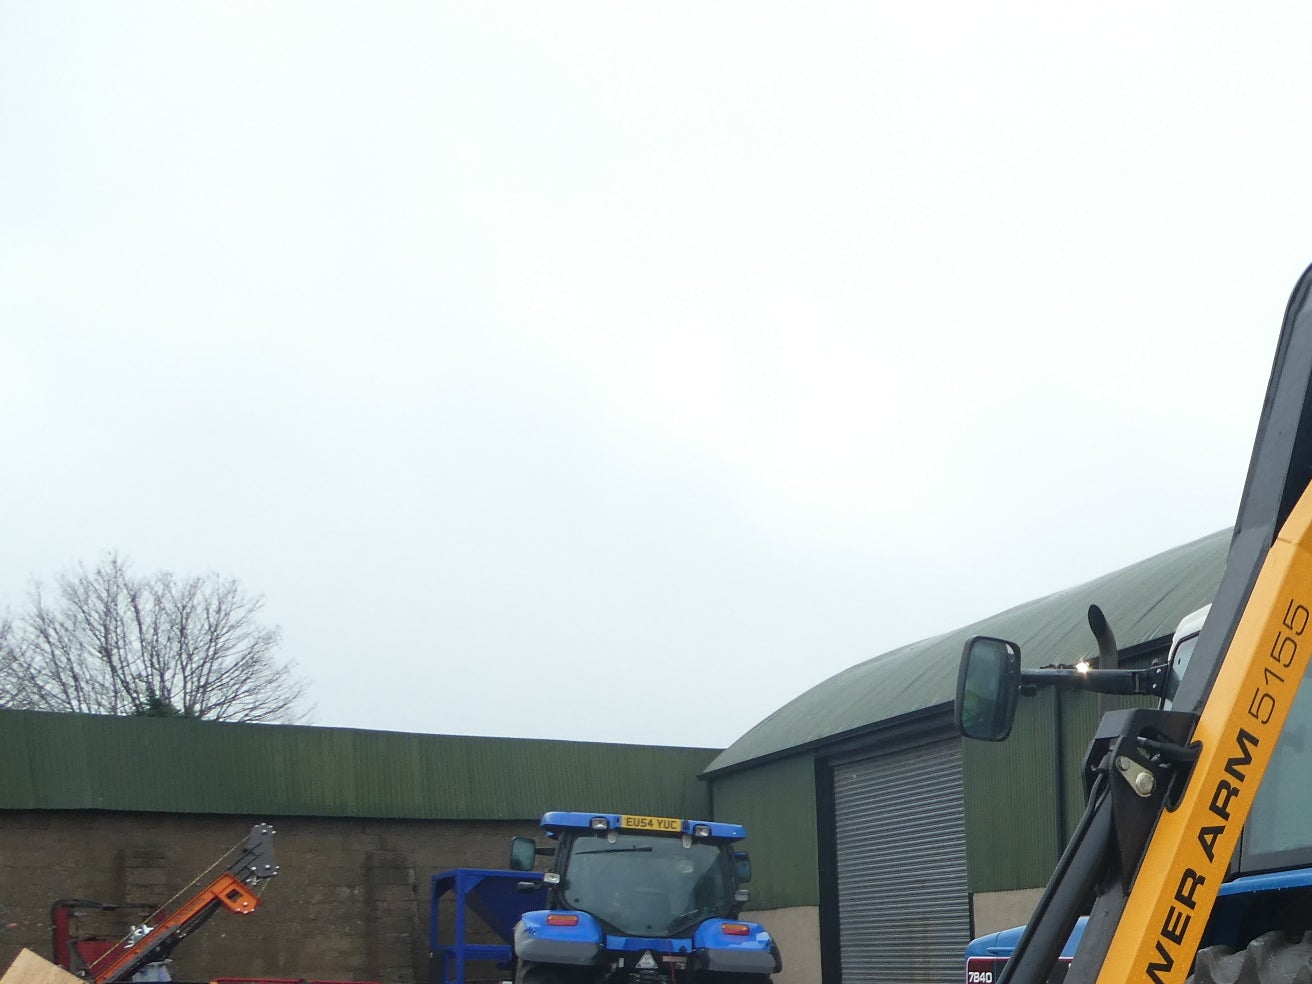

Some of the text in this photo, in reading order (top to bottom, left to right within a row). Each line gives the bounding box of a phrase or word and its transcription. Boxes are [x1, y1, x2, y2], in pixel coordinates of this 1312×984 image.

[1197, 728, 1260, 864] ARM
[1248, 598, 1310, 725] 5155
[626, 817, 677, 830] EU54 YUC
[968, 971, 993, 984] 7840
